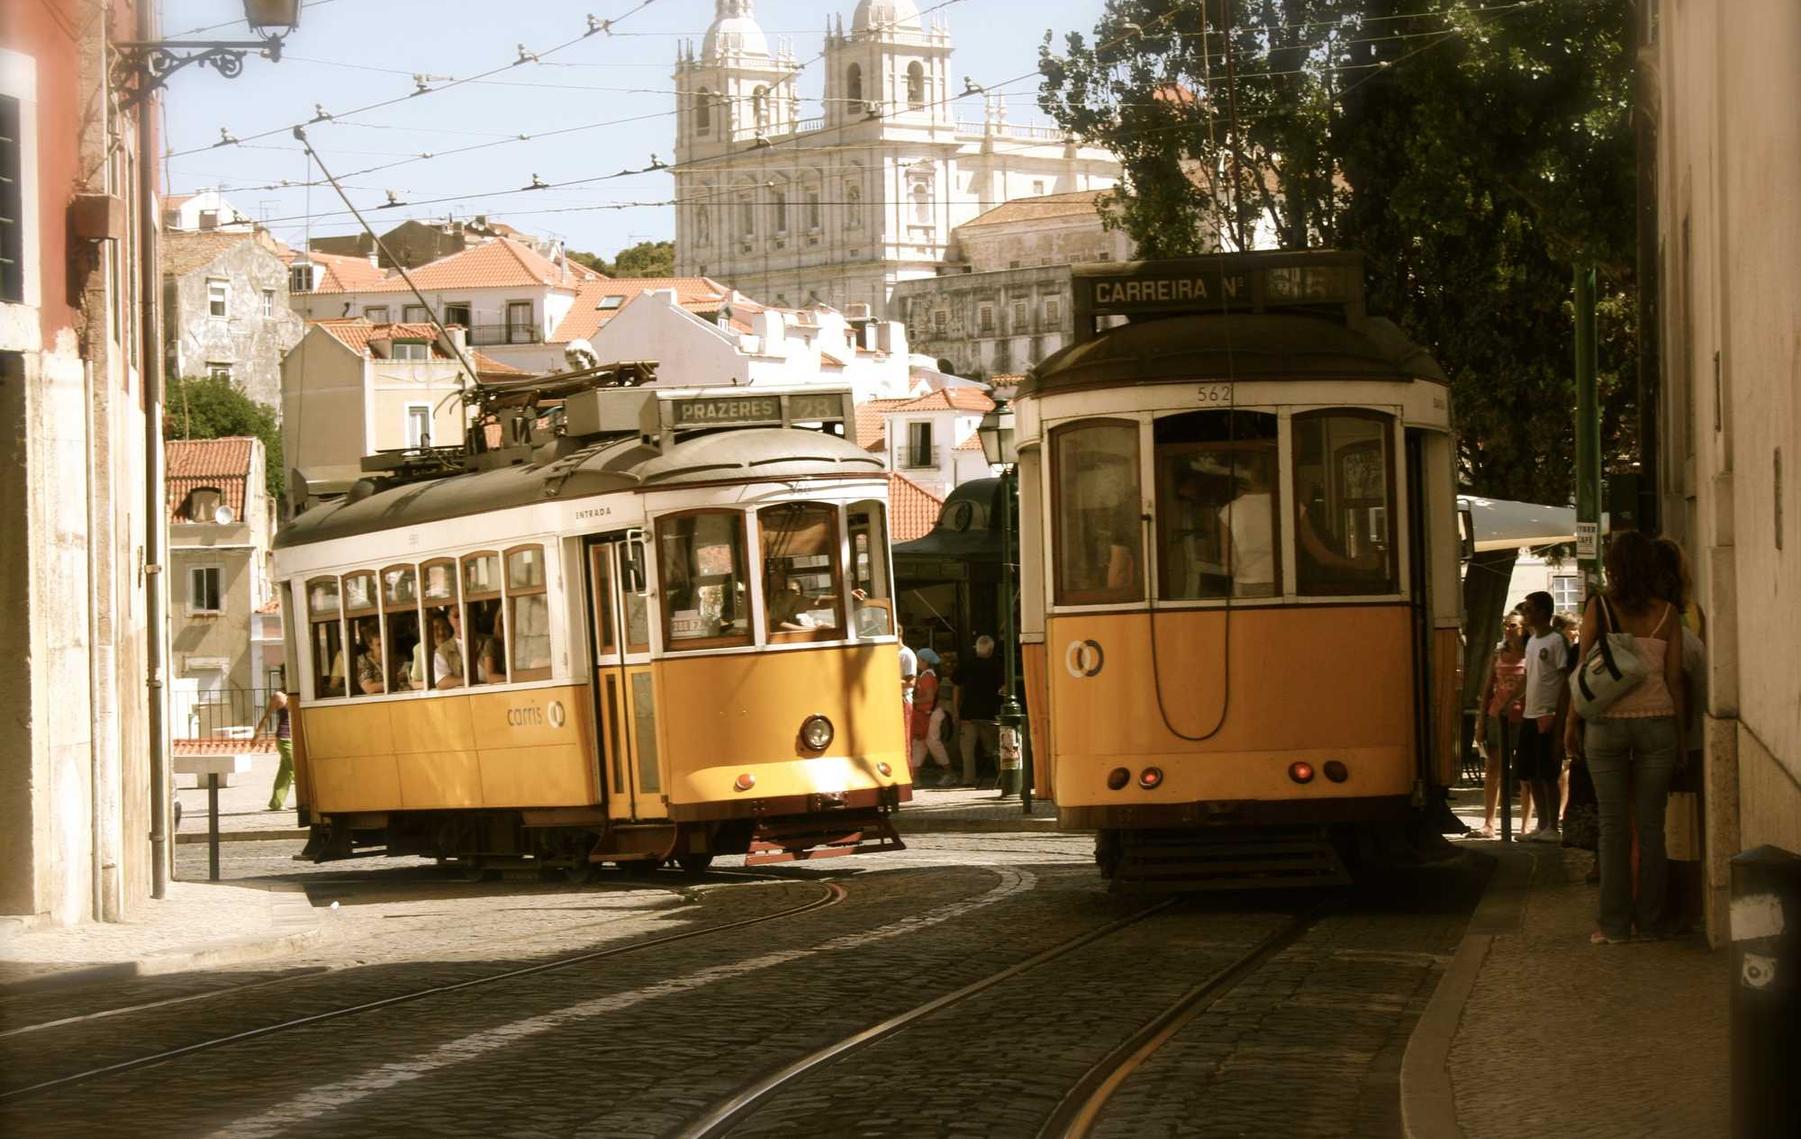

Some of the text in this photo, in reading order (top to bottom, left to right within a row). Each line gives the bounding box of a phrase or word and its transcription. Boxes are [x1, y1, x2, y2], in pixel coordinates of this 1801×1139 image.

[1096, 279, 1207, 303] CARREIRA
[1197, 385, 1230, 402] 562
[681, 398, 832, 420] PRAZERES 28
[506, 699, 543, 727] carris
